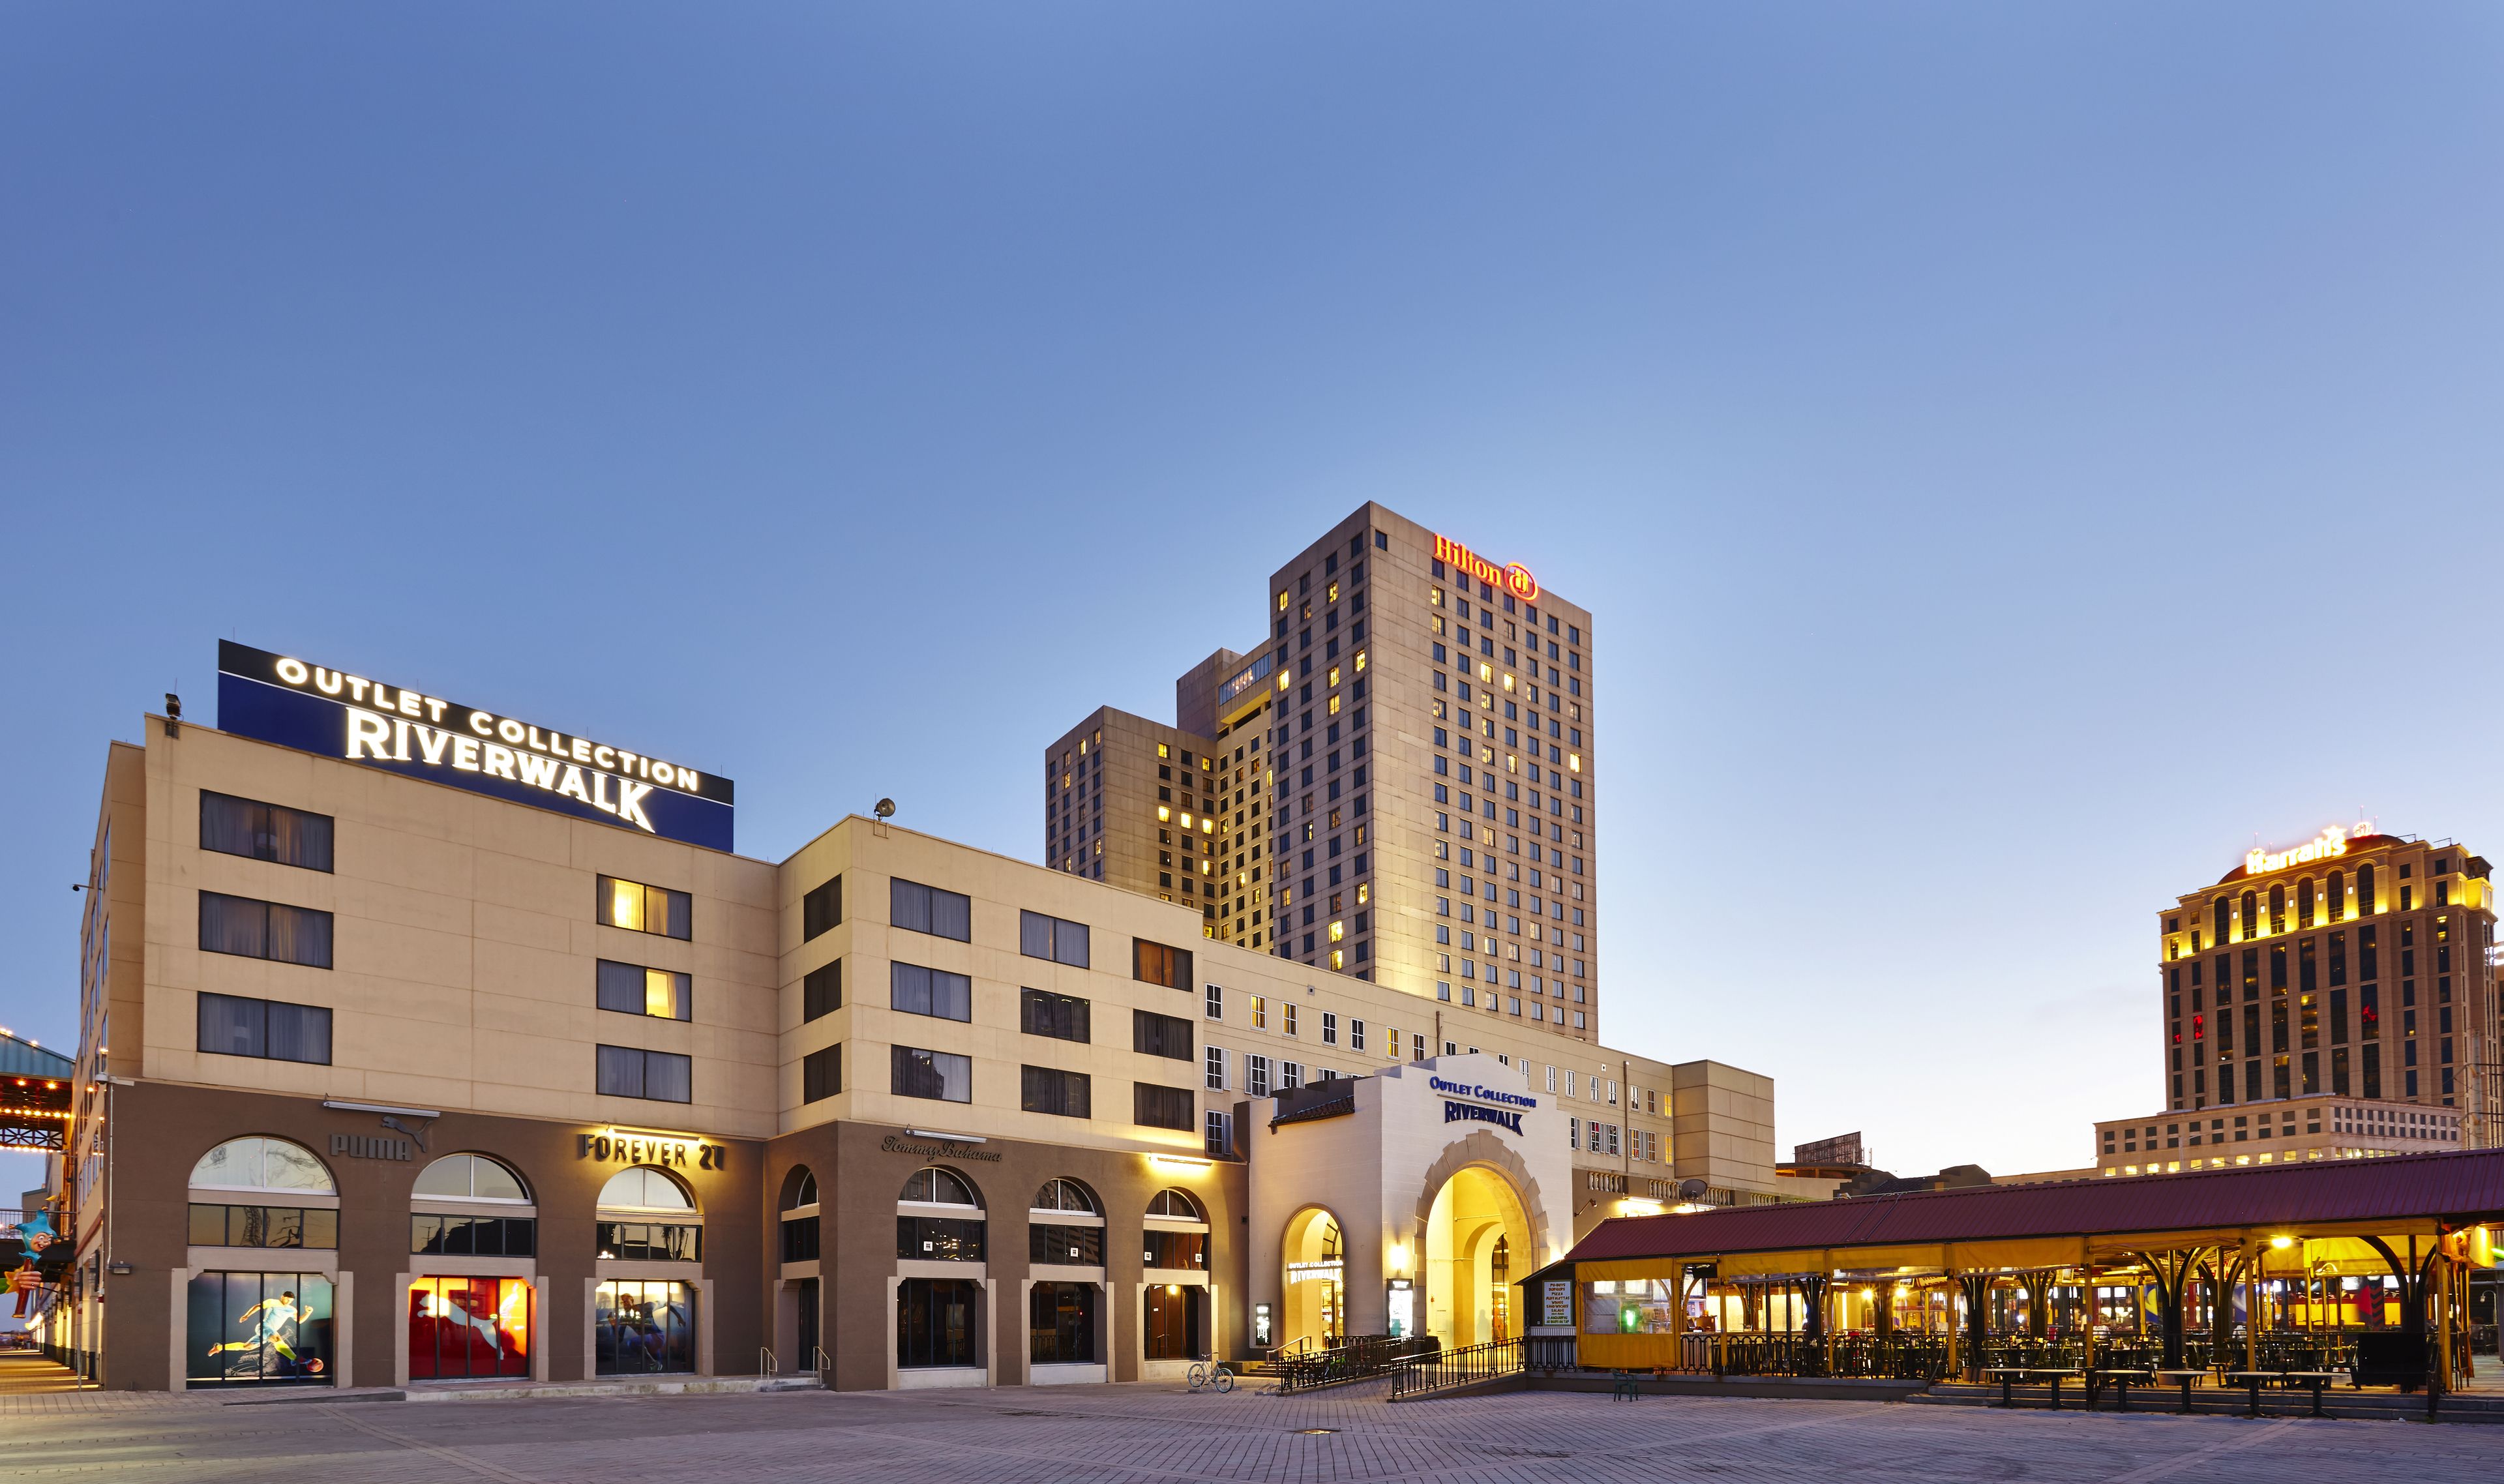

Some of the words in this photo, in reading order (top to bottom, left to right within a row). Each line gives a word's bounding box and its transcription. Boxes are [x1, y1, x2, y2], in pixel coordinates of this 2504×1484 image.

[1435, 533, 1502, 587] Hilton
[275, 657, 448, 722] OUTLET
[469, 711, 699, 793] COLLECTION
[346, 706, 656, 835] RIVERWALK
[1429, 1076, 1472, 1095] OUTLET
[1474, 1085, 1537, 1108] COLLECTION
[1444, 1101, 1524, 1137] RIVERWALK
[329, 1133, 413, 1161] PUMA
[579, 1133, 687, 1165] FOREVER
[698, 1144, 725, 1169] 21
[882, 1135, 943, 1162] Tommy
[938, 1142, 1002, 1163] Bahama
[1290, 1268, 1343, 1284] RIVERWALK
